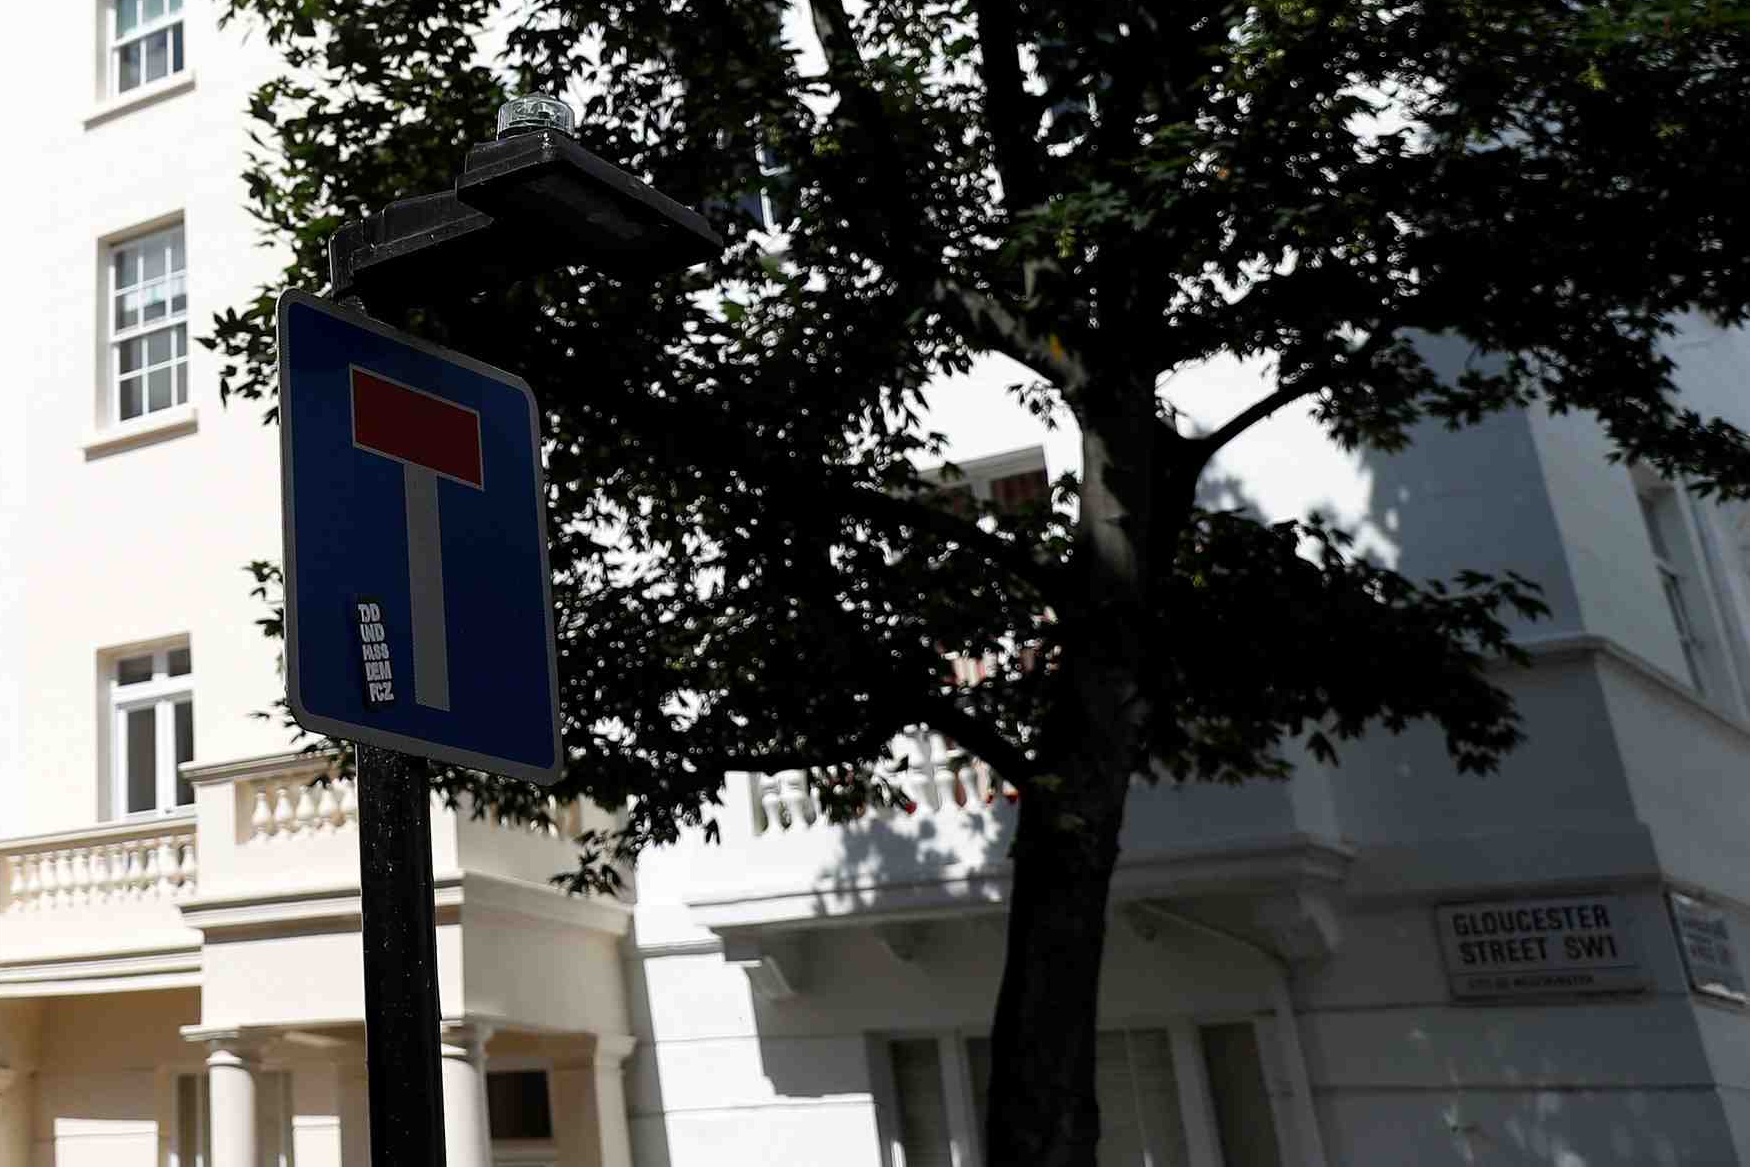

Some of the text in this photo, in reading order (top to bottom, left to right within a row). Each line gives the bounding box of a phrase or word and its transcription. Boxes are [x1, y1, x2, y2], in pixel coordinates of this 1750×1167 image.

[360, 623, 385, 643] UND
[365, 660, 392, 681] DEM
[369, 681, 394, 702] FCZ
[1452, 904, 1611, 936] GLOUCESTER
[1459, 934, 1618, 965] STREET SW1
